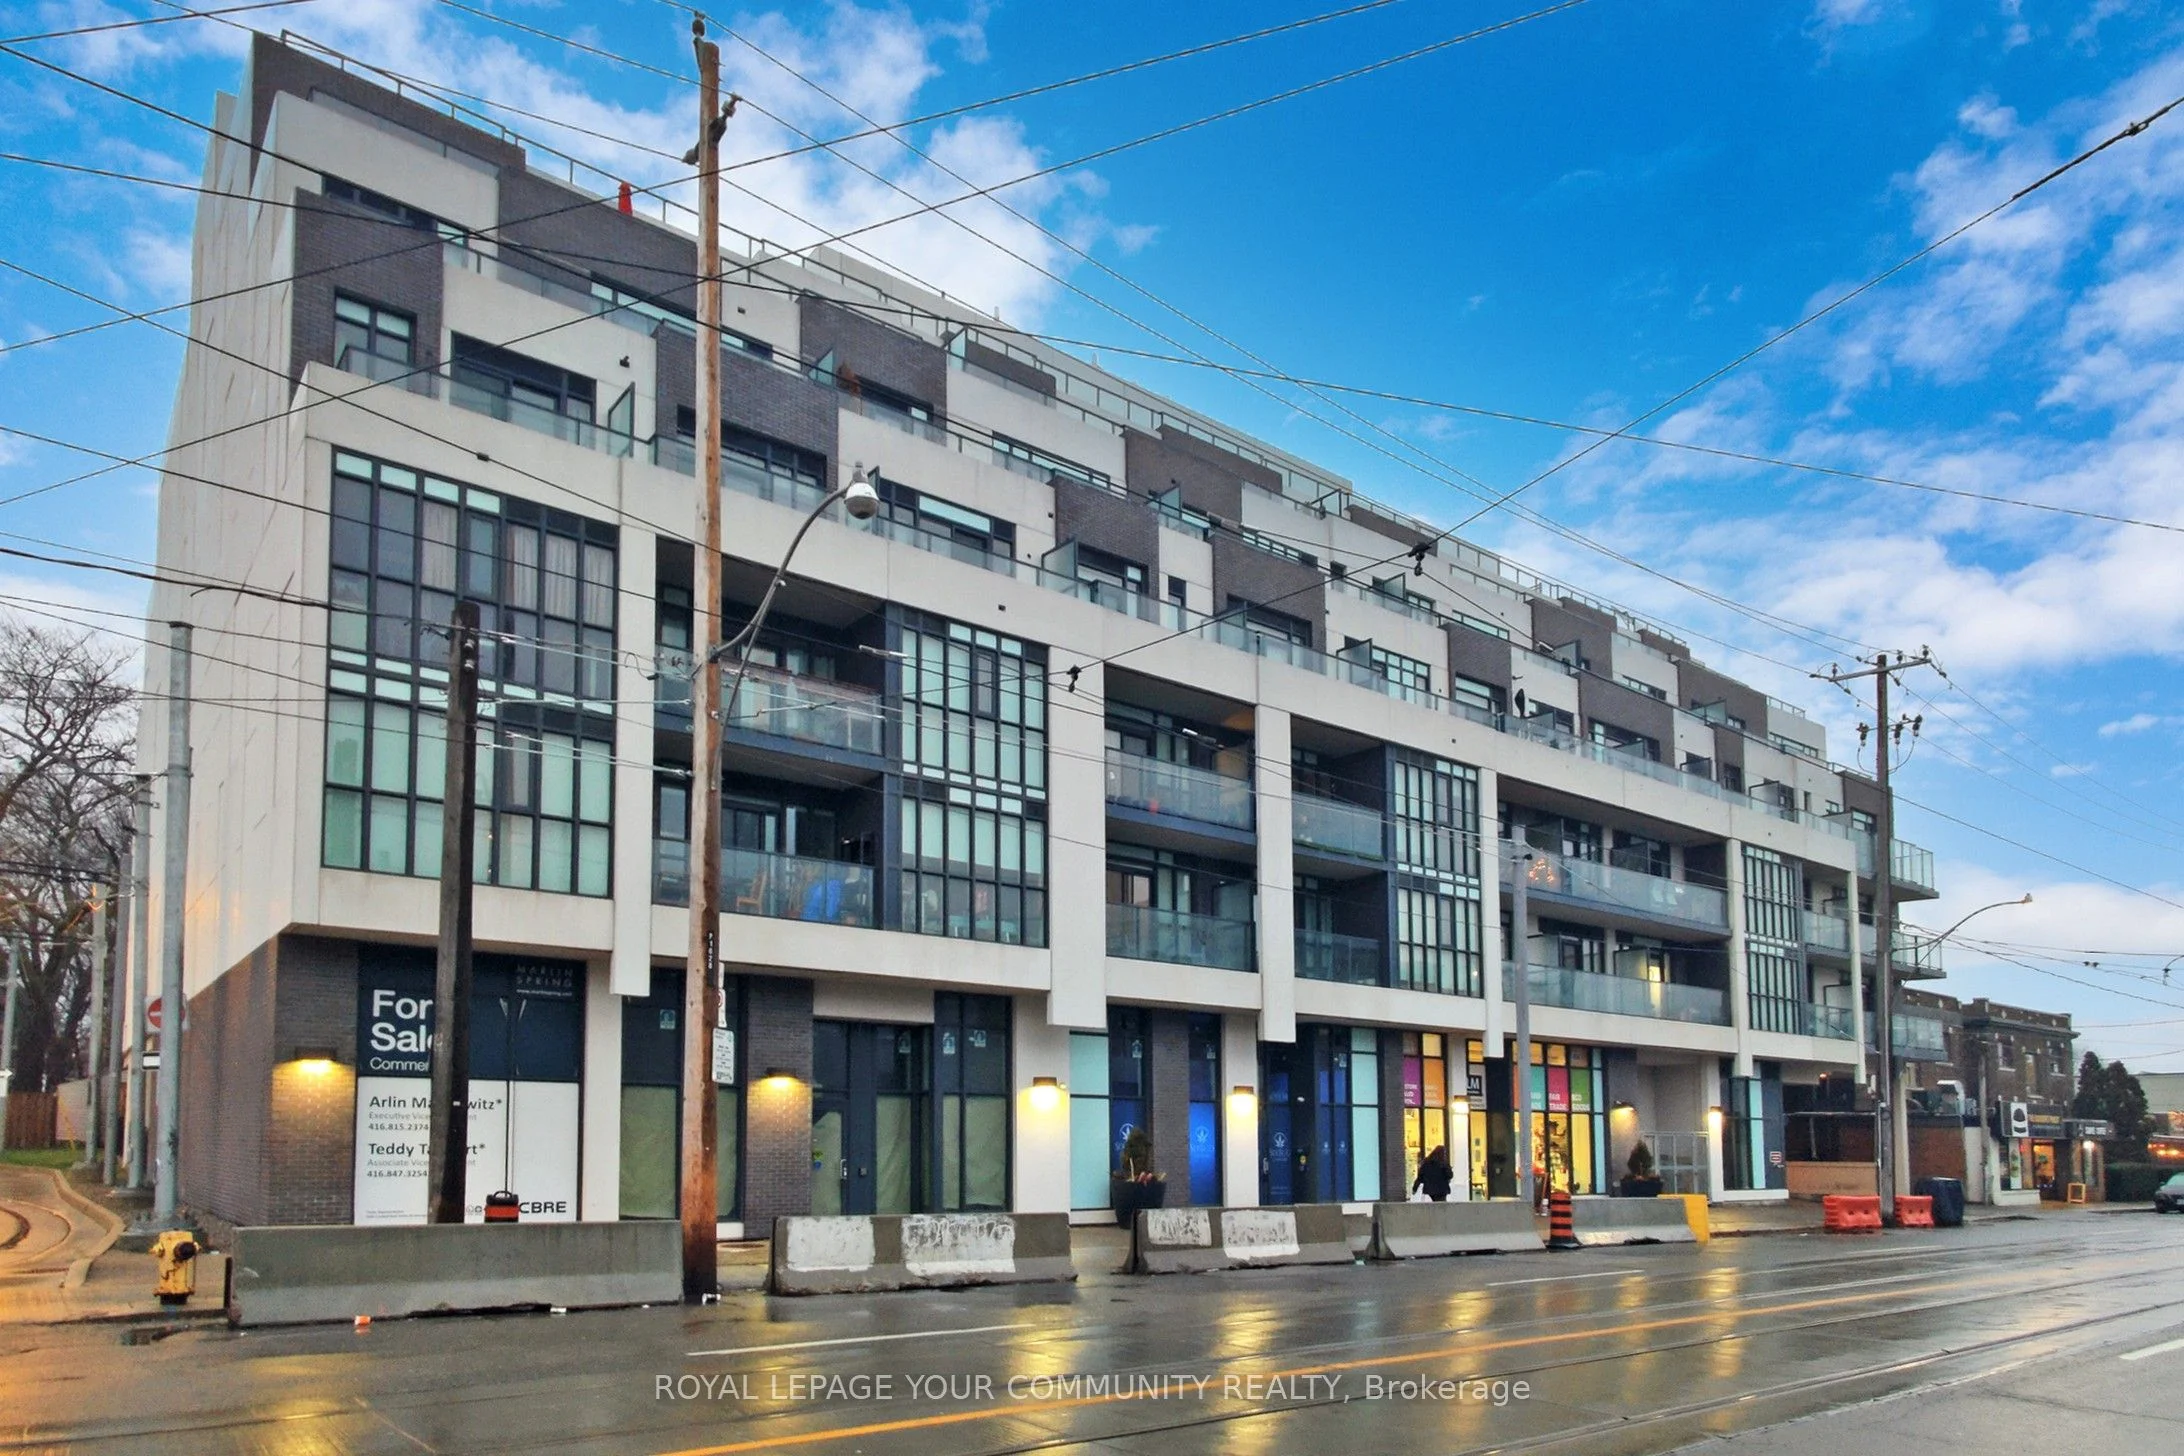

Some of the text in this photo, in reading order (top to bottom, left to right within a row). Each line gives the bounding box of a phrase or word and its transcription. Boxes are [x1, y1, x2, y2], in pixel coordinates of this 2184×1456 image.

[372, 989, 434, 1019] For
[369, 1096, 407, 1108] Arlin
[369, 1143, 415, 1157] Teddy
[519, 1201, 567, 1214] CBRE
